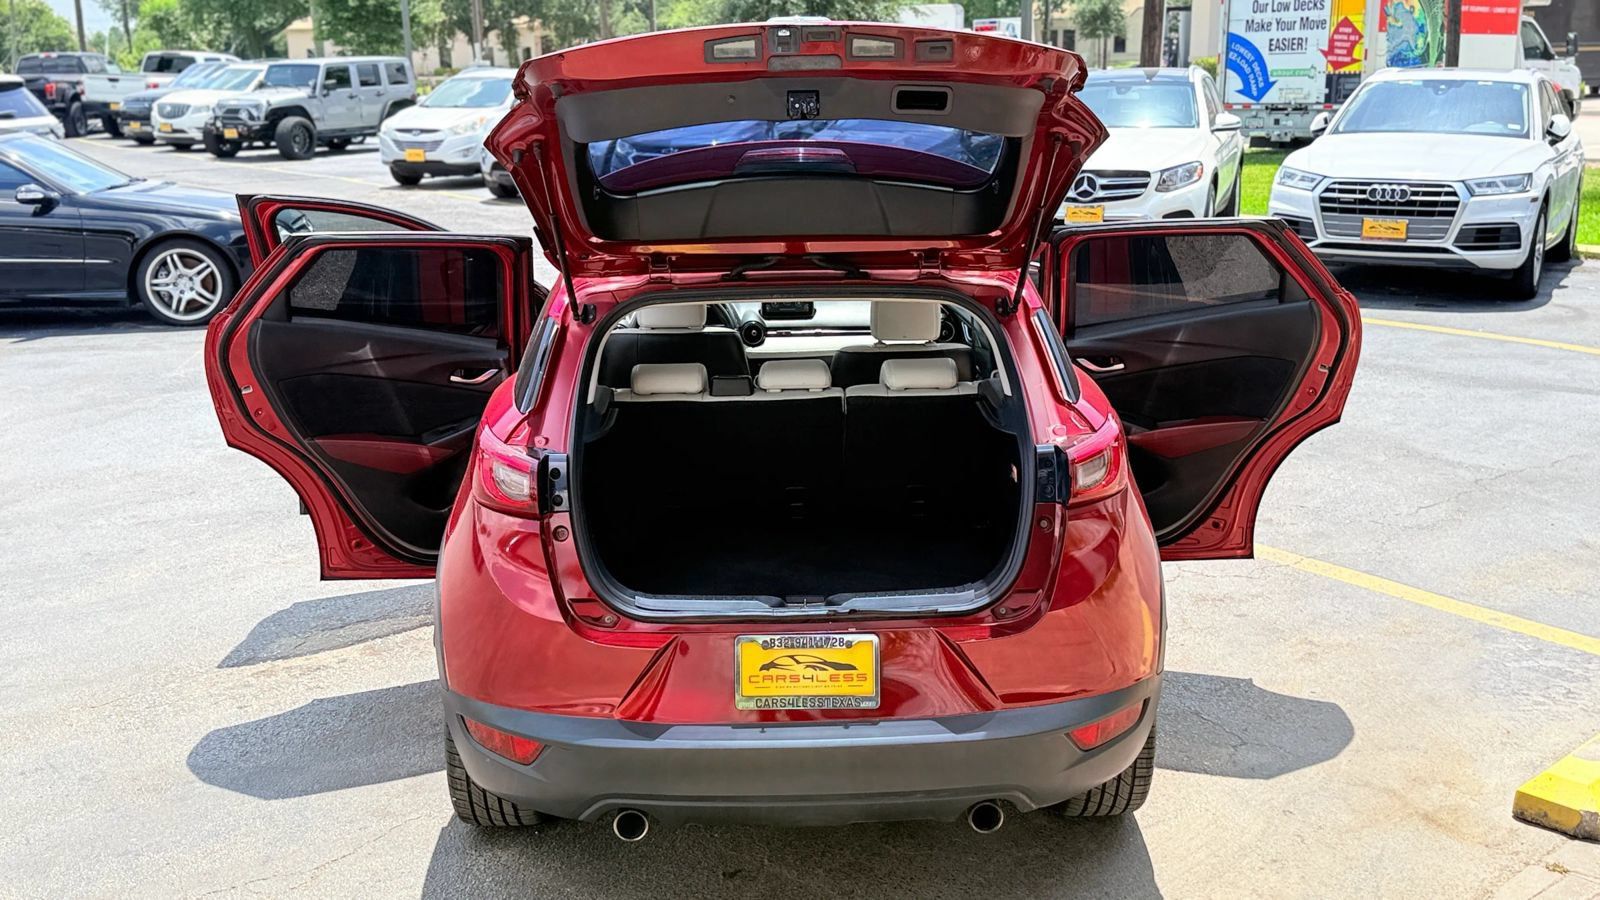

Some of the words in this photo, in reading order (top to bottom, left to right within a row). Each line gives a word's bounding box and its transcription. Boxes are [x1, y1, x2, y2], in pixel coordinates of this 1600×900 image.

[1252, 0, 1268, 13] Our
[1271, 0, 1291, 13] Low
[1293, 0, 1325, 11] Decks
[1245, 19, 1273, 33] Make
[1275, 18, 1296, 32] Your
[1299, 16, 1327, 31] Move
[1268, 37, 1308, 52] EASIER!
[1231, 42, 1255, 62] LOWEST
[1252, 61, 1264, 88] DECKS
[748, 673, 867, 684] CARS4LESS
